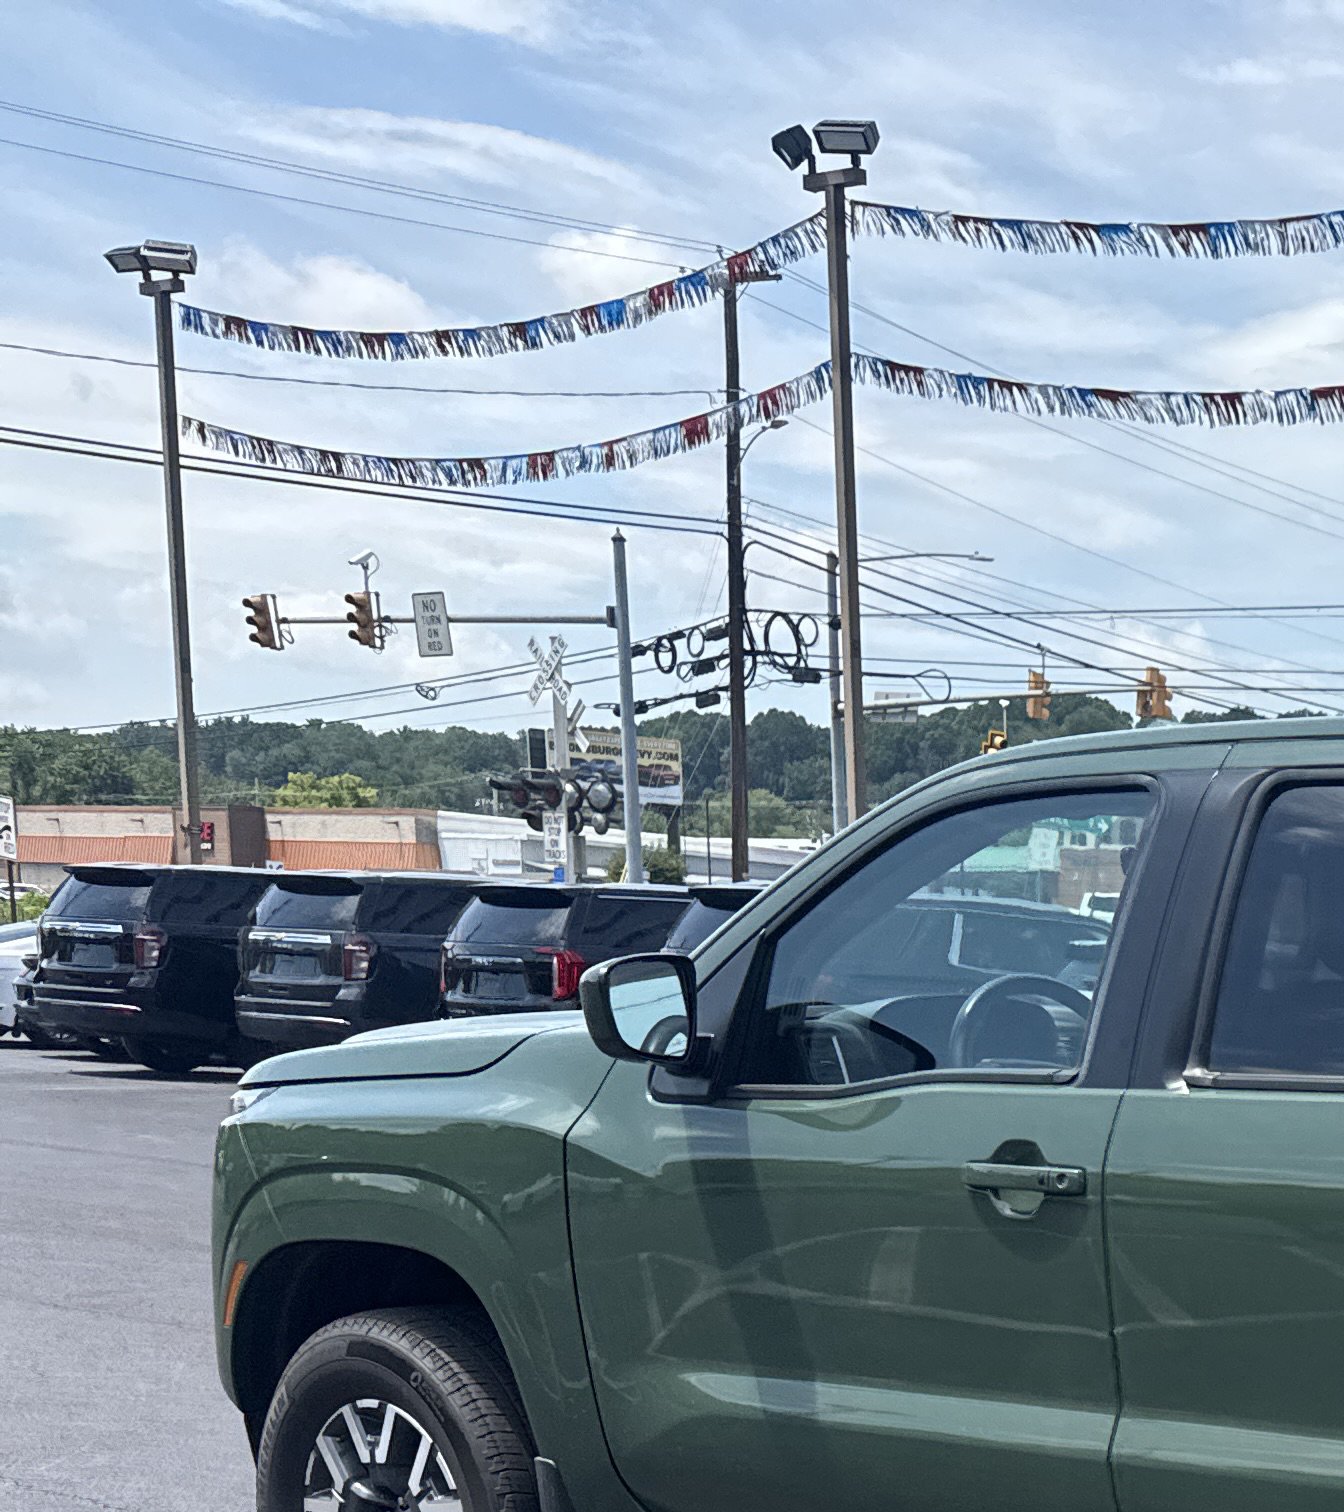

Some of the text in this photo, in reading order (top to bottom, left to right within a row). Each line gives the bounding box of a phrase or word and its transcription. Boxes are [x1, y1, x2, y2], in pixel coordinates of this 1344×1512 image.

[421, 599, 437, 612] NO
[421, 615, 442, 625] TURN
[427, 628, 440, 639] ON
[427, 640, 443, 651] RED
[529, 636, 566, 701] CROSSING
